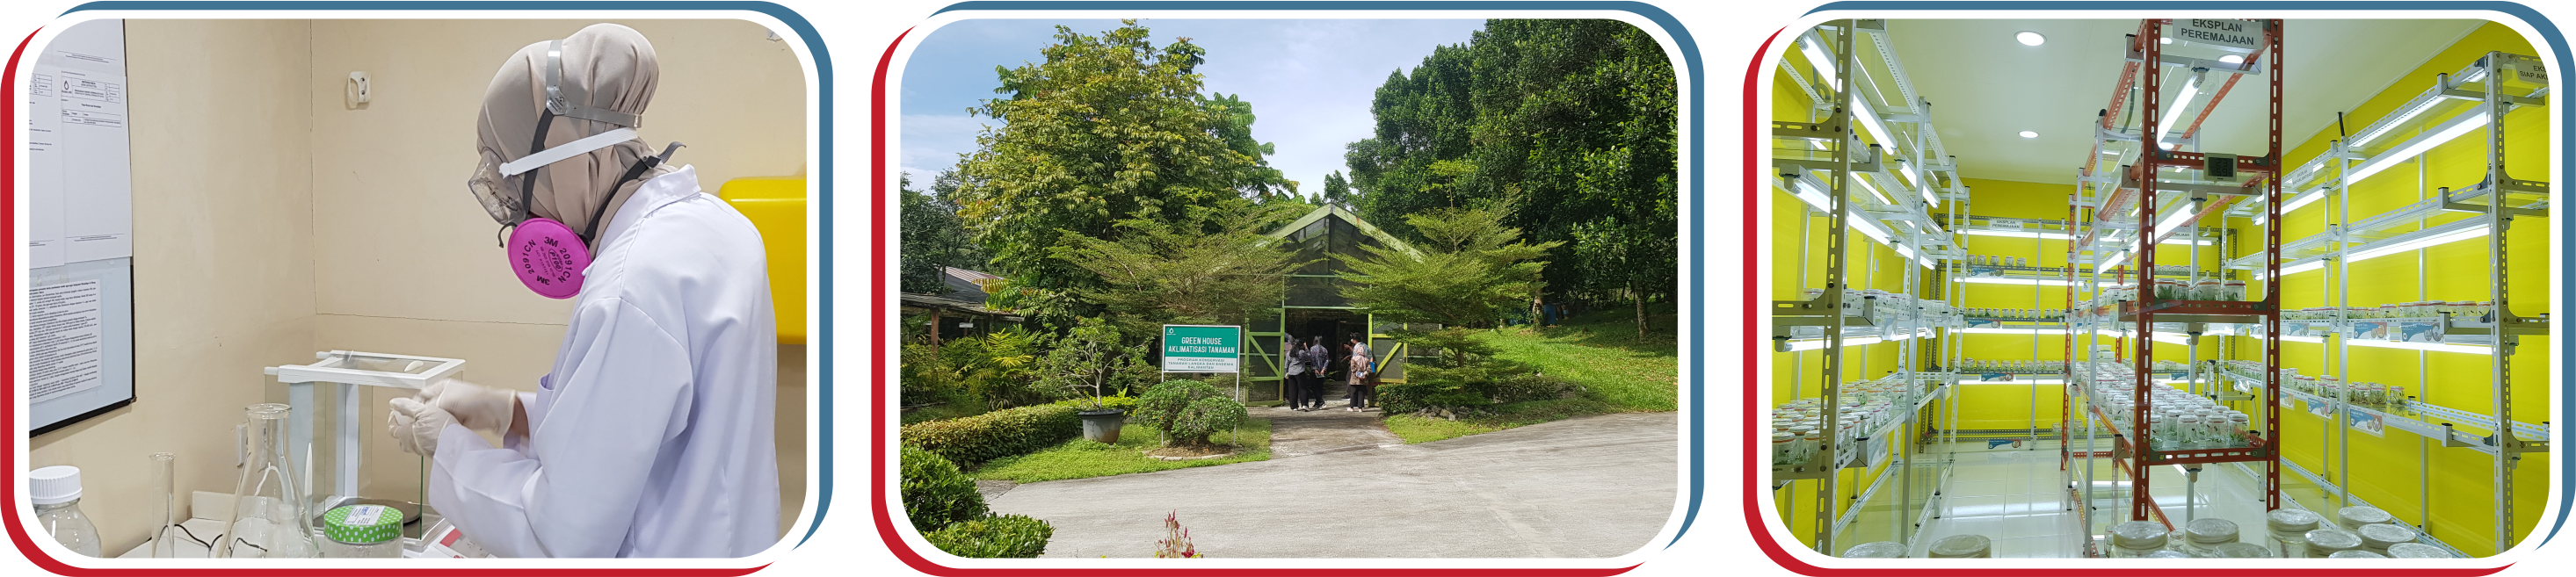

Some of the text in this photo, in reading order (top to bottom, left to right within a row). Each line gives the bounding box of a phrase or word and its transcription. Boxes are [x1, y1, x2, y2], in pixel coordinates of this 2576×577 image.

[2192, 18, 2242, 32] EKSPLAN
[2181, 27, 2254, 46] PEREMAJAAN
[522, 239, 536, 275] 2091CN
[544, 236, 559, 248] 3M
[558, 248, 572, 283] 2091CN
[549, 251, 562, 270] P100
[536, 275, 550, 285] 3M
